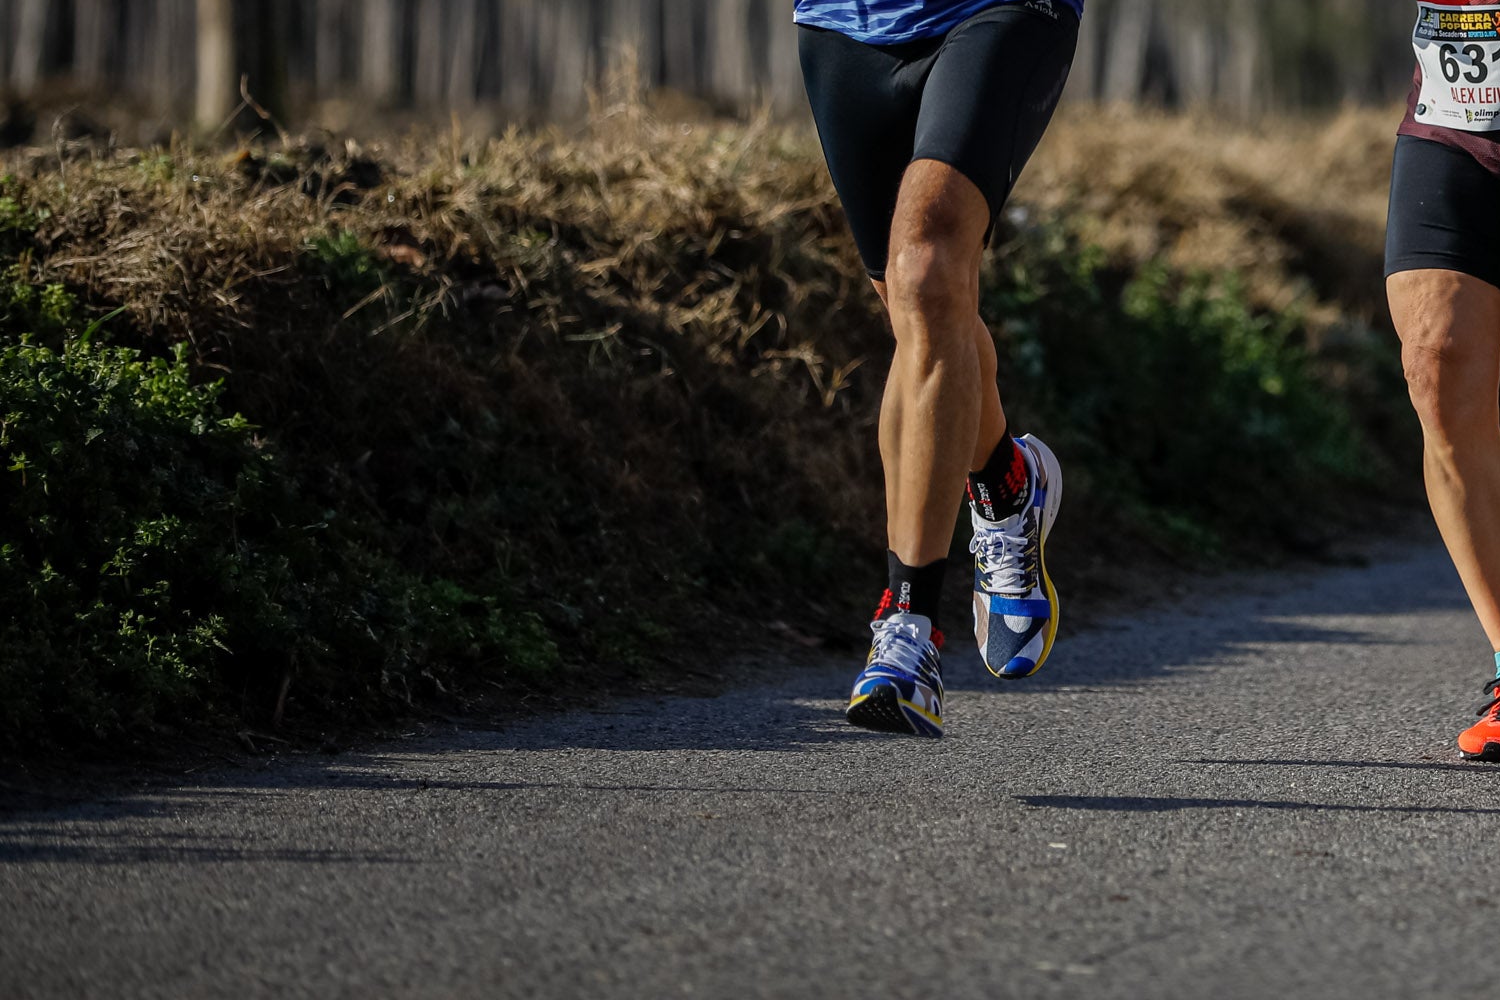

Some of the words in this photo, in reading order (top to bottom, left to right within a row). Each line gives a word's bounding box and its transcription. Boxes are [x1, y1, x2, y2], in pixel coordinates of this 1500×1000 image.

[1439, 13, 1492, 23] CARRERA
[1440, 22, 1493, 31] POPULAR
[1438, 30, 1467, 38] Secaderos
[1450, 87, 1477, 104] ALEX
